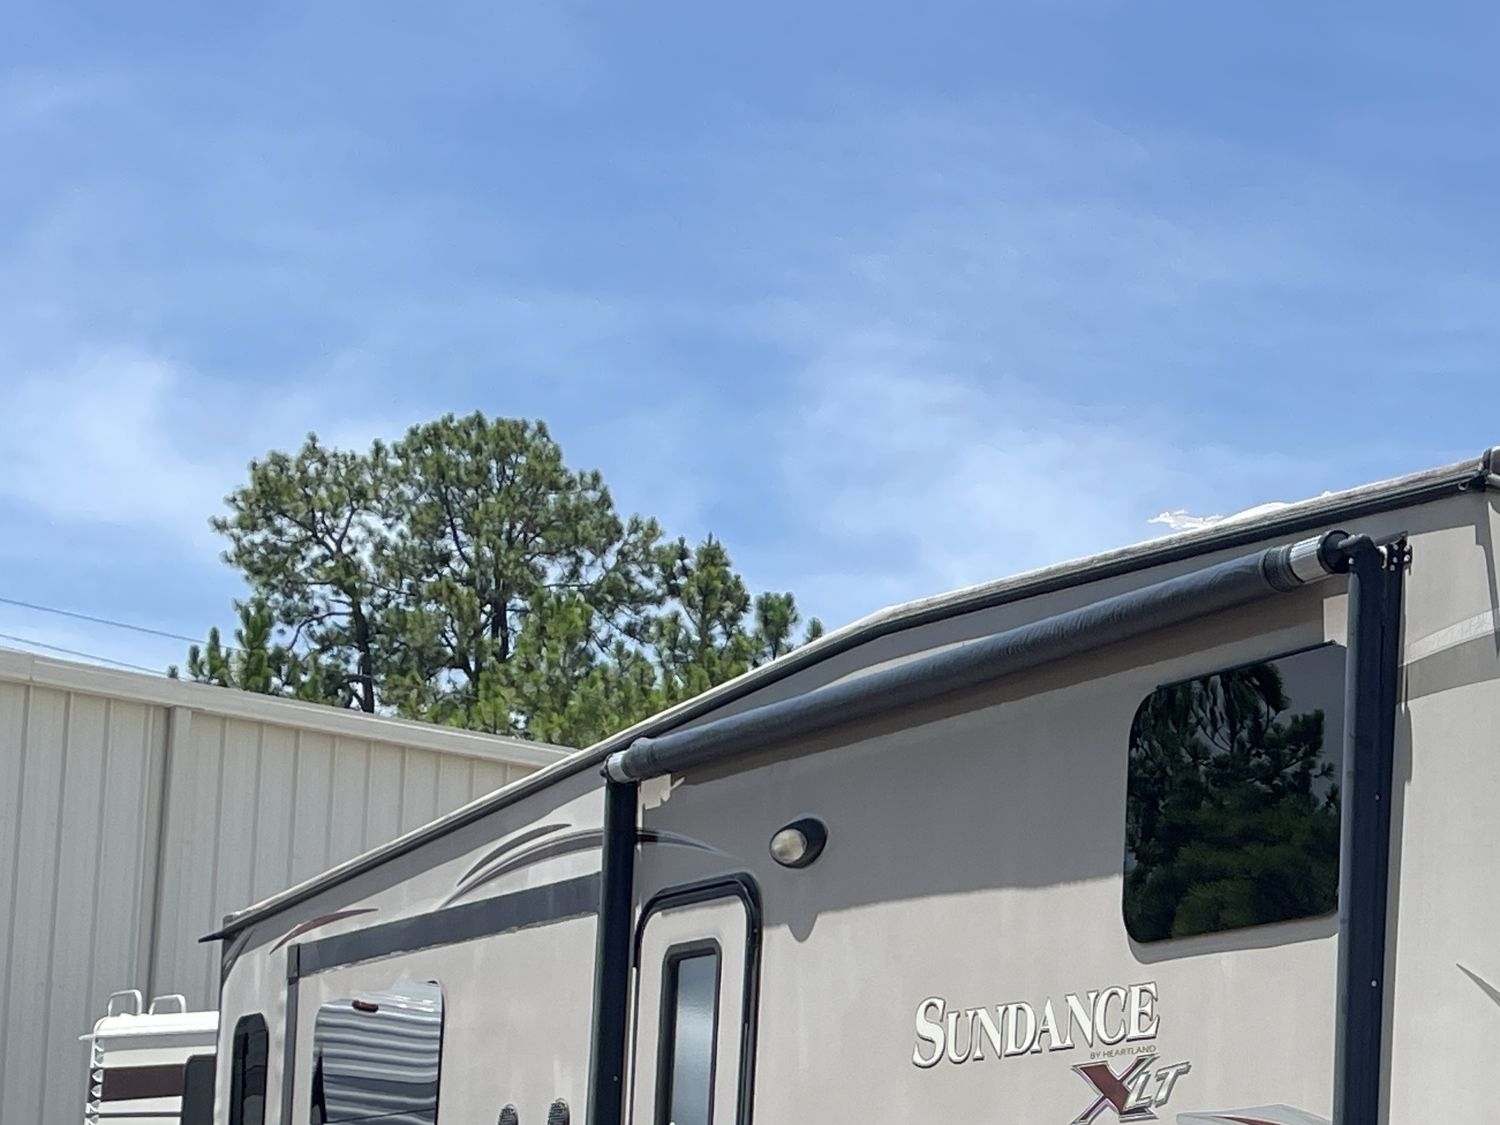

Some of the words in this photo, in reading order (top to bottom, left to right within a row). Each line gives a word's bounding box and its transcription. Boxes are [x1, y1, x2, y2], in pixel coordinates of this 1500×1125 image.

[912, 982, 1160, 1069] SUNDANCE
[1089, 1051, 1101, 1060] BY
[1102, 1044, 1157, 1058] HEARTLAND
